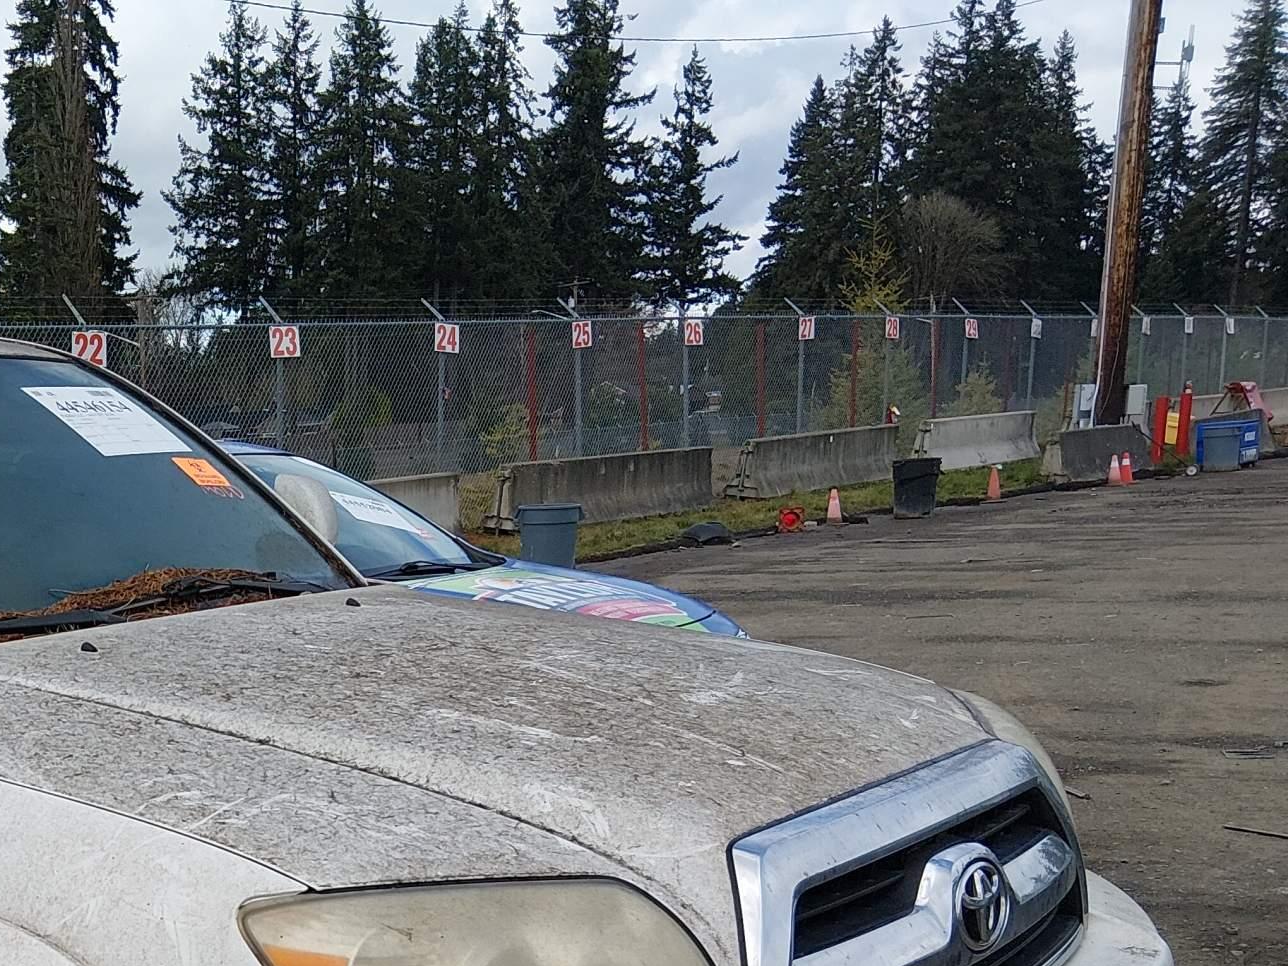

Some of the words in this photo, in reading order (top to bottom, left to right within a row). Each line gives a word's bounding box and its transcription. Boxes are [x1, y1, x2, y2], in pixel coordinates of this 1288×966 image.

[436, 324, 457, 351] 24
[573, 322, 591, 347] 25
[685, 322, 702, 344] 26
[800, 318, 813, 338] 27
[886, 318, 899, 338] 28
[965, 319, 978, 338] 29
[74, 333, 104, 366] 22
[271, 327, 298, 357] 23
[55, 400, 133, 413] 44546154
